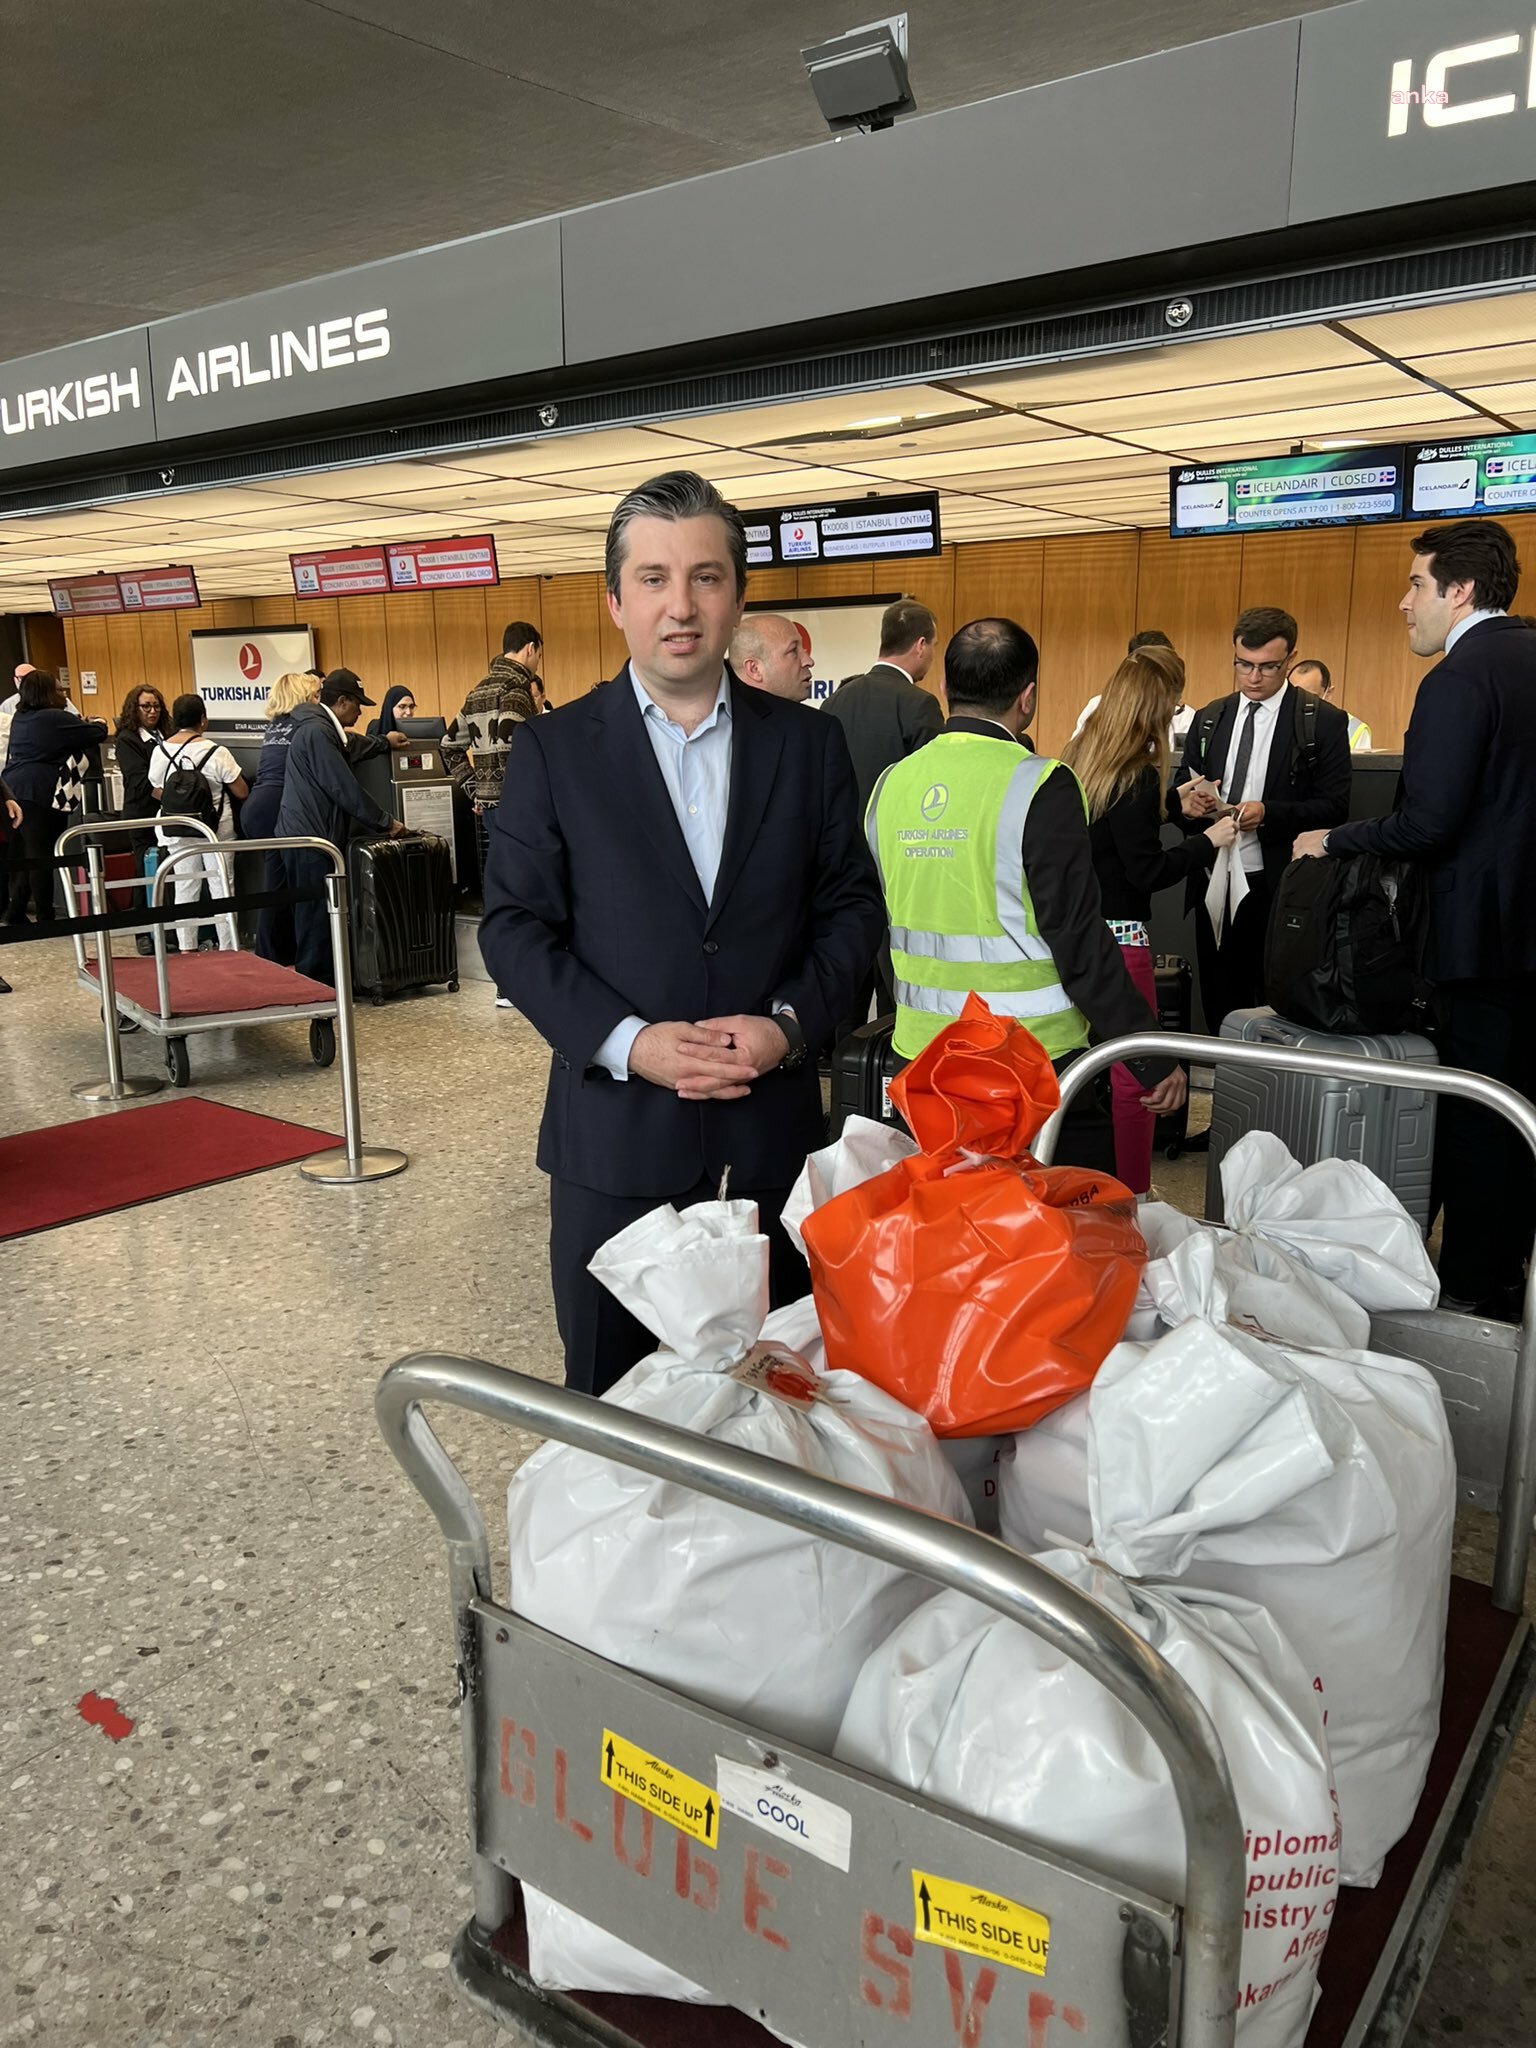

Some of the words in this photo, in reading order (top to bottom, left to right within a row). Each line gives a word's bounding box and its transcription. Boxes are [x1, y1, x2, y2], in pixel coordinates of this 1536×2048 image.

[1388, 28, 1536, 137] IC
[0, 366, 141, 435] URKISH
[166, 307, 391, 402] AIRLINES
[1508, 459, 1536, 472] ICEL
[1253, 477, 1318, 493] ICELANDAIR
[1330, 473, 1376, 487] CLOSED
[1419, 483, 1459, 491] ICELANDAIR
[1488, 489, 1528, 499] COUNTER
[1181, 503, 1214, 511] ICELANDAIR
[1238, 508, 1272, 519] COUNTER
[1273, 507, 1297, 516] OPENS
[1298, 506, 1308, 514] AT
[1309, 504, 1328, 513] 17:00
[1336, 499, 1392, 511] 1-800-223-5500
[856, 518, 892, 529] ISTANBUL
[900, 514, 931, 525] ONTIME
[201, 686, 252, 701] TURKISH
[896, 829, 929, 842] TURKISH
[931, 828, 969, 841] AIRLINES
[904, 847, 954, 859] OPERATION
[616, 1761, 647, 1791] THIS
[649, 1783, 681, 1812] SIDE
[684, 1801, 703, 1821] UP
[757, 1798, 810, 1839] COOL
[1246, 1864, 1336, 1899] public
[933, 1906, 977, 1935] THIS
[981, 1921, 1023, 1950] SIDE
